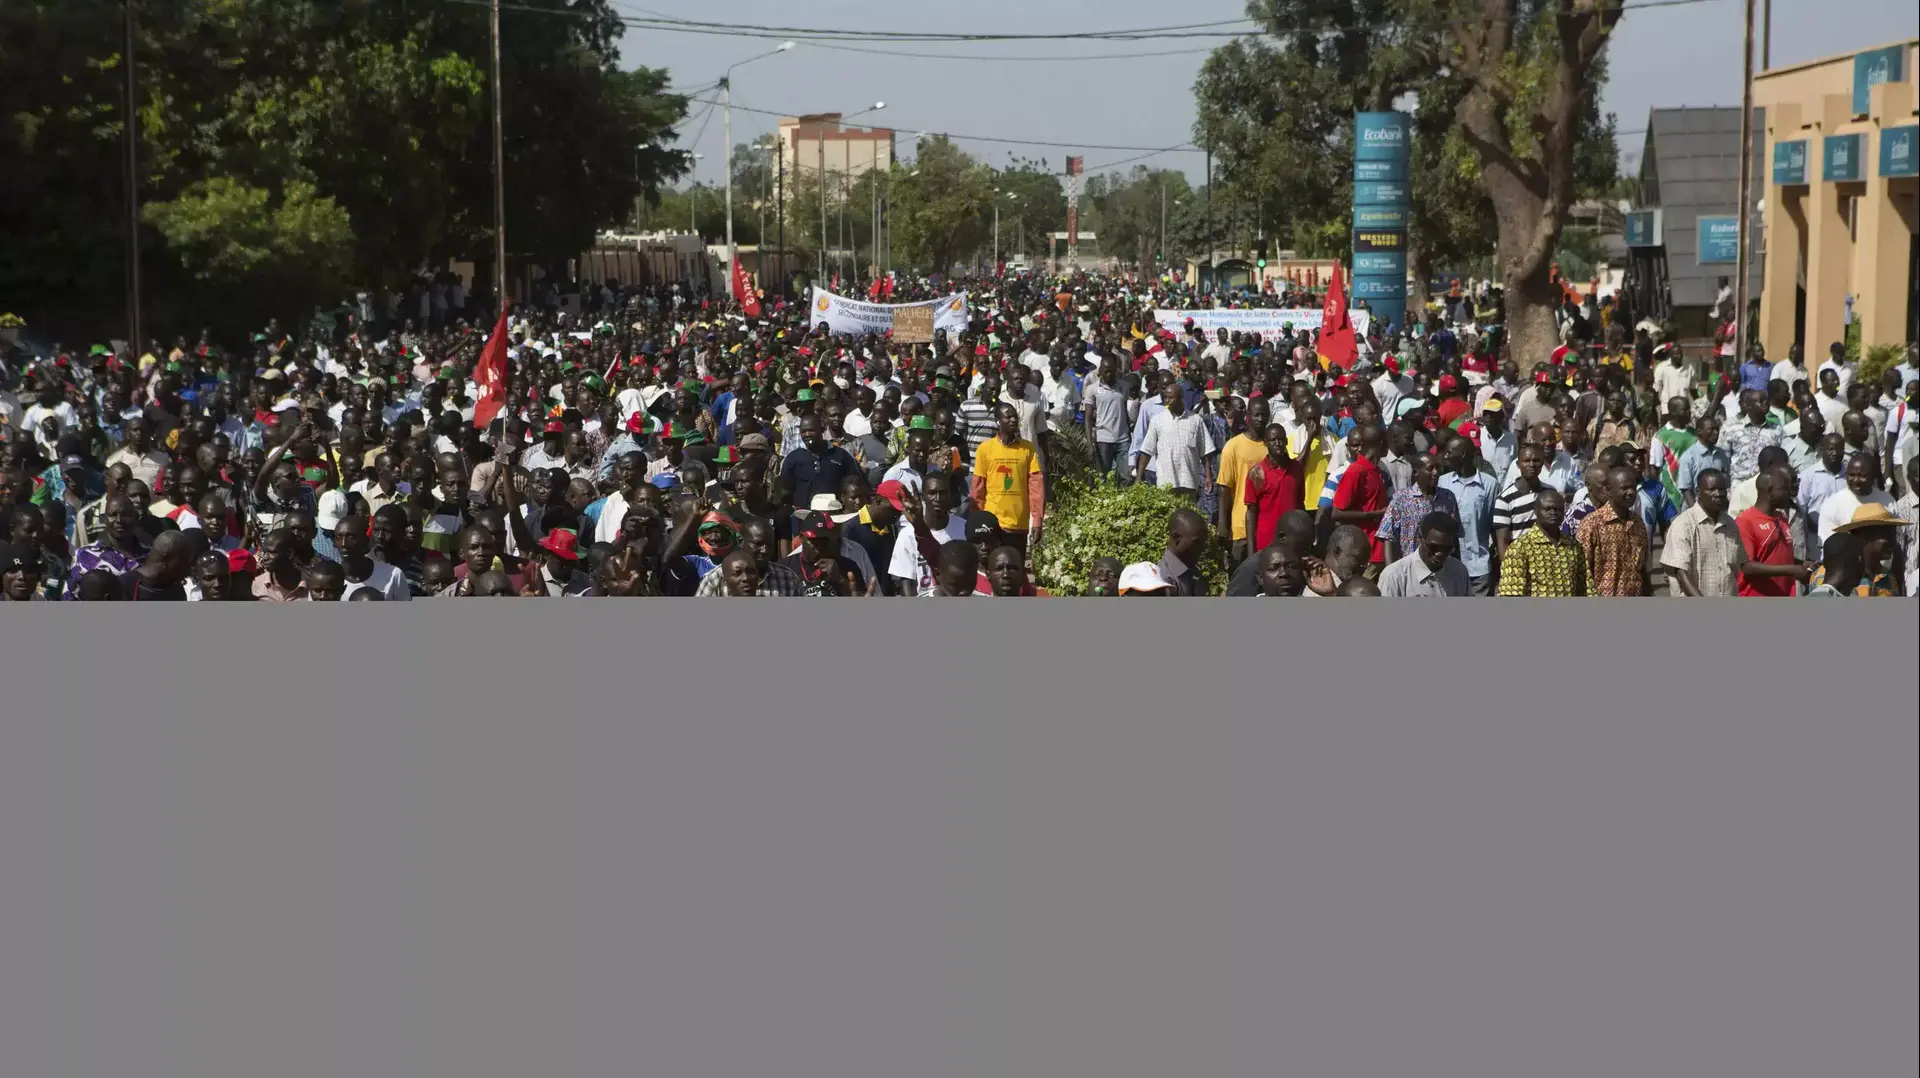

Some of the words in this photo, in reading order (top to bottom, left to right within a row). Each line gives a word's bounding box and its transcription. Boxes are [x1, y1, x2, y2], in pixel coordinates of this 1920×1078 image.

[1363, 127, 1403, 140] Ecobank
[834, 299, 858, 312] SYNDICAT
[858, 304, 886, 314] NATIONAL
[838, 308, 870, 321] SECONDAIRE
[862, 325, 878, 333] VIVE
